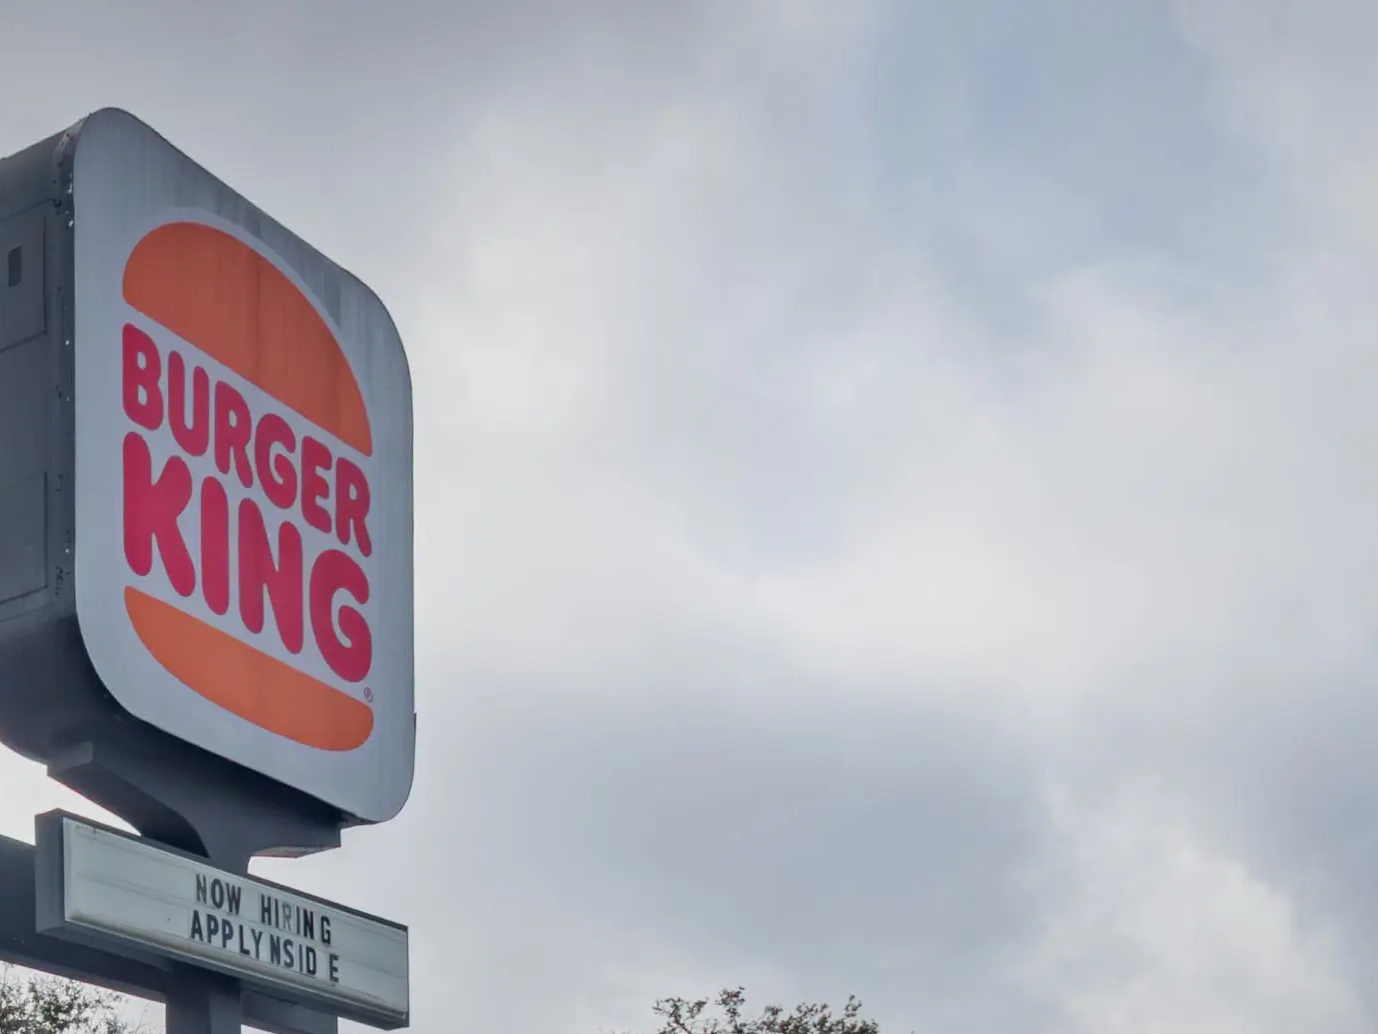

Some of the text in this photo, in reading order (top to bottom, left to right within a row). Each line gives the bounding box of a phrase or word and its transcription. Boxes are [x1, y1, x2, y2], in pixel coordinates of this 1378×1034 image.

[122, 323, 372, 557] BURGER
[123, 432, 373, 682] KING
[196, 873, 331, 944] NOW HIRING
